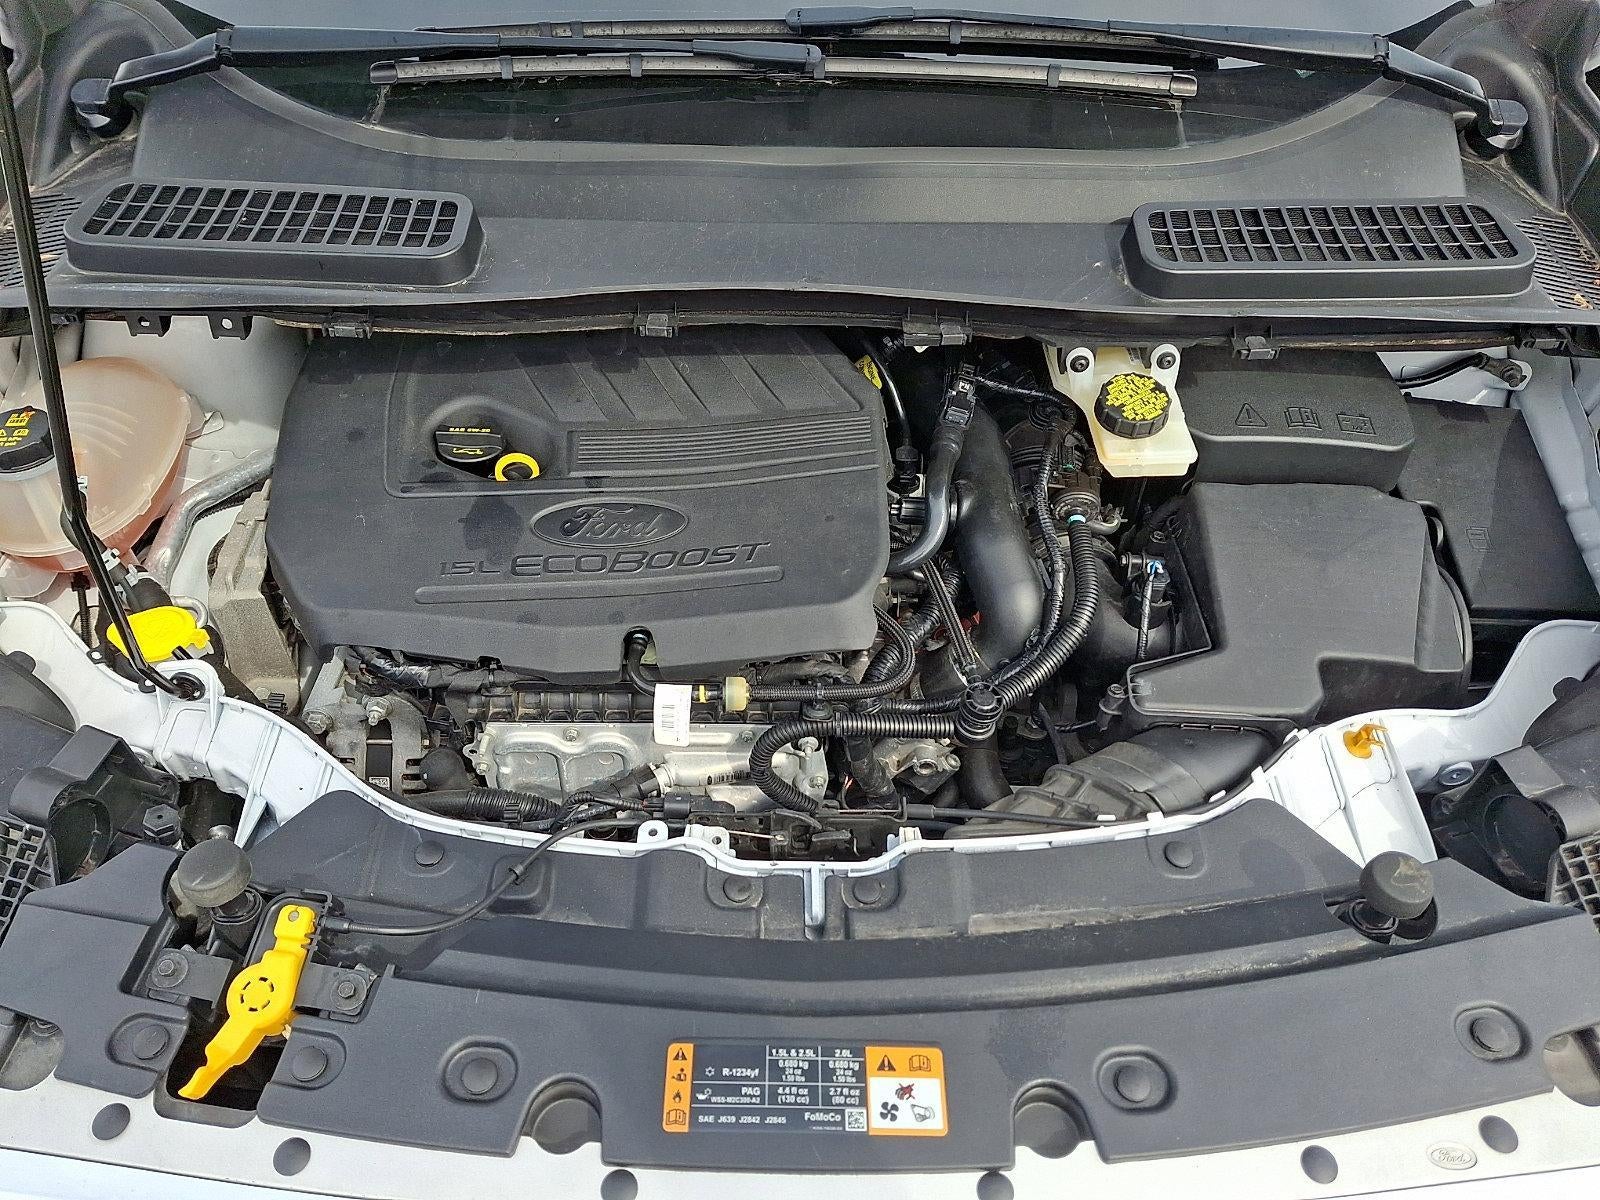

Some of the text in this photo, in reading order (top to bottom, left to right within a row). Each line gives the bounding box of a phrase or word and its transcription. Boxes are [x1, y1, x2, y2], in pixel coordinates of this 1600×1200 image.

[558, 506, 664, 539] Ford
[510, 542, 771, 577] ECOBOOST
[771, 1048, 816, 1057] 1.5L & 2.5L
[799, 1060, 809, 1070] kg
[849, 1061, 860, 1071] kg
[722, 1067, 760, 1078] R-1234yf
[741, 1086, 761, 1096] PAG
[777, 1087, 790, 1095] 4.4
[791, 1086, 797, 1095] fl
[829, 1087, 841, 1096] 2.7
[842, 1087, 849, 1096] fl
[796, 1096, 810, 1105] cc)
[846, 1097, 859, 1105] cc)
[698, 1115, 714, 1123] SAE
[717, 1115, 736, 1123] J639
[804, 1111, 842, 1122] FoMoCo
[1438, 1148, 1467, 1162] Ford
